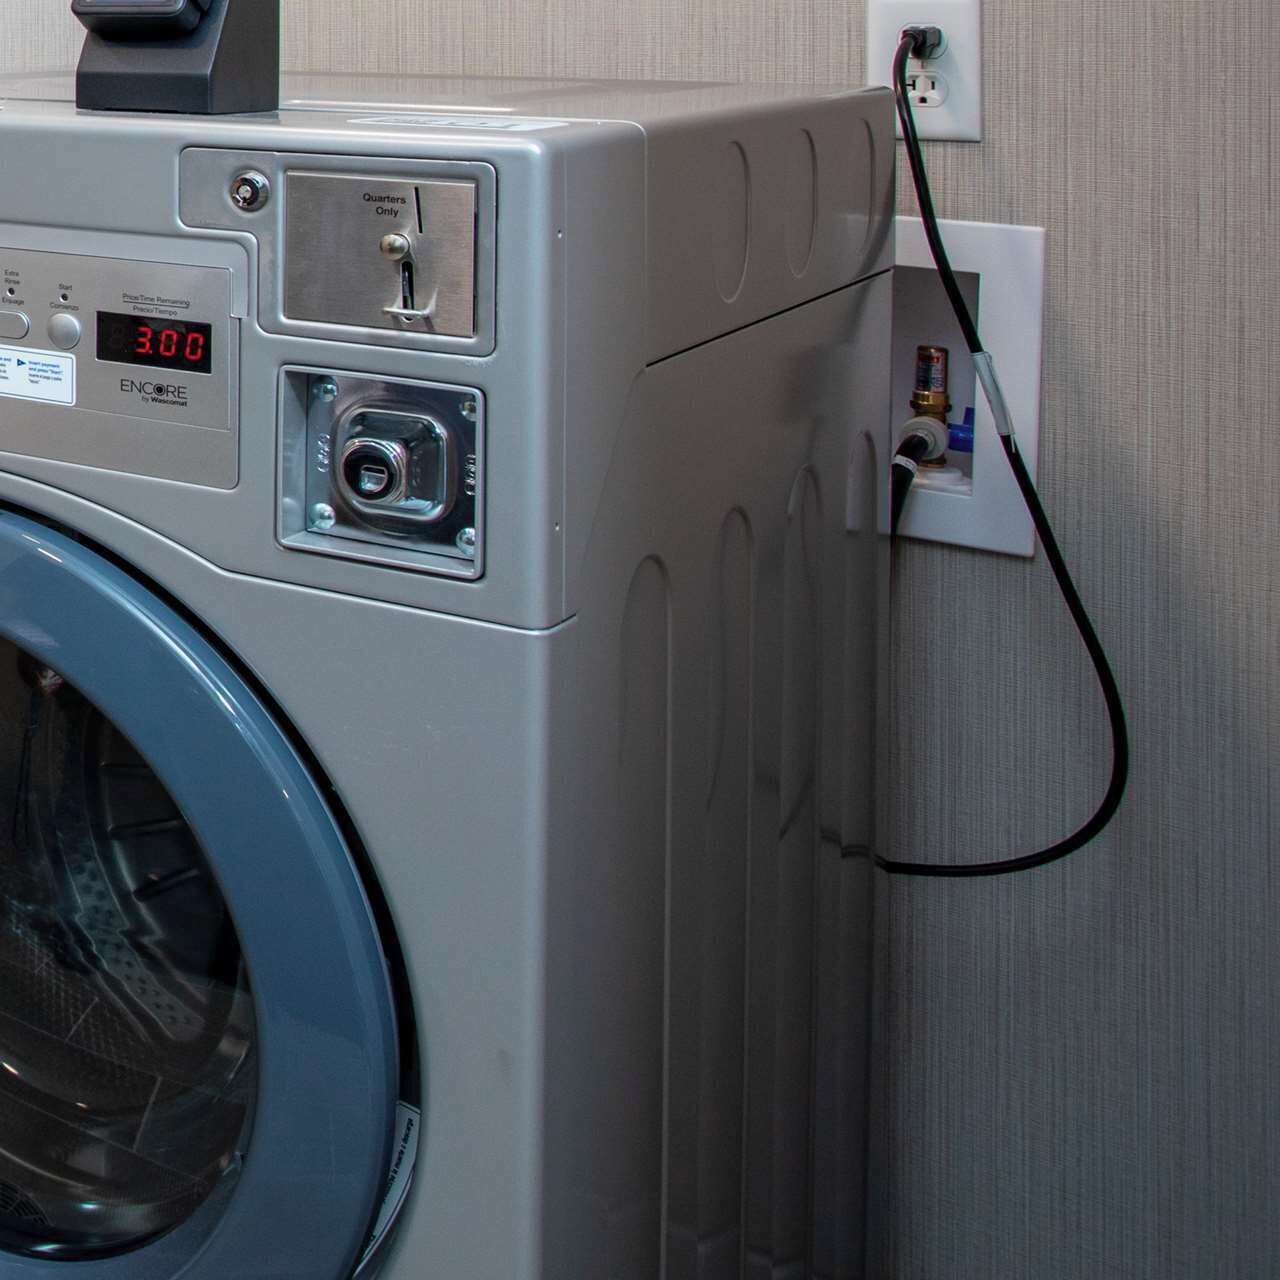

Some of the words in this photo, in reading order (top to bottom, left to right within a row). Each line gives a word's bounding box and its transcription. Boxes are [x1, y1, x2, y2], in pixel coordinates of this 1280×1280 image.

[363, 193, 406, 204] Quarters
[376, 206, 399, 218] Only
[135, 327, 204, 361] 3.00
[120, 379, 188, 399] ENCORE
[151, 396, 188, 407] Wascomat
